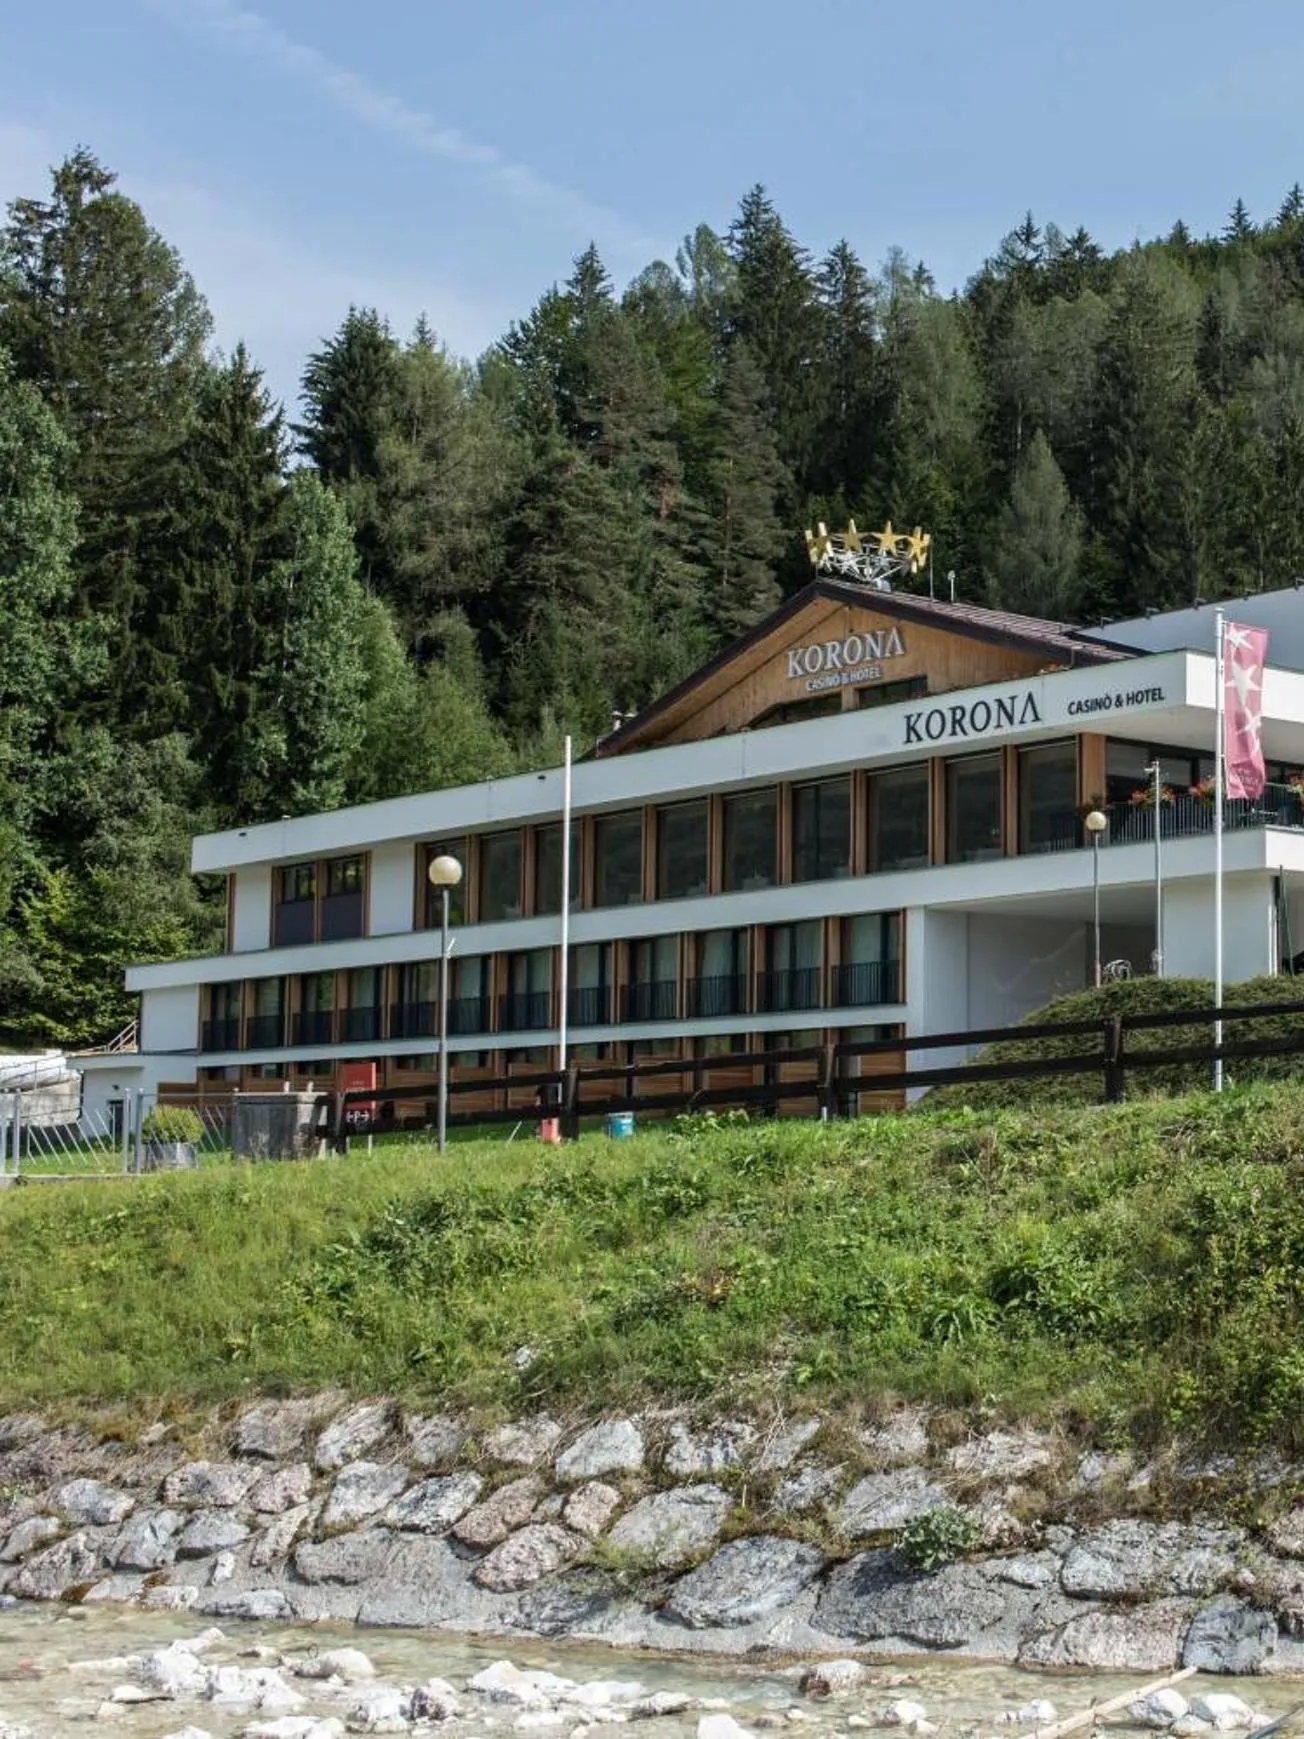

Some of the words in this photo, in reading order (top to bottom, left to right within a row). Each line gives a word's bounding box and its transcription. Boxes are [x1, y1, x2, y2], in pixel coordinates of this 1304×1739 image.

[787, 626, 905, 678] KORONA
[850, 666, 881, 682] HOTEL
[903, 691, 1042, 744] KORONA
[1114, 693, 1124, 708] &
[1126, 687, 1165, 706] HOTEL
